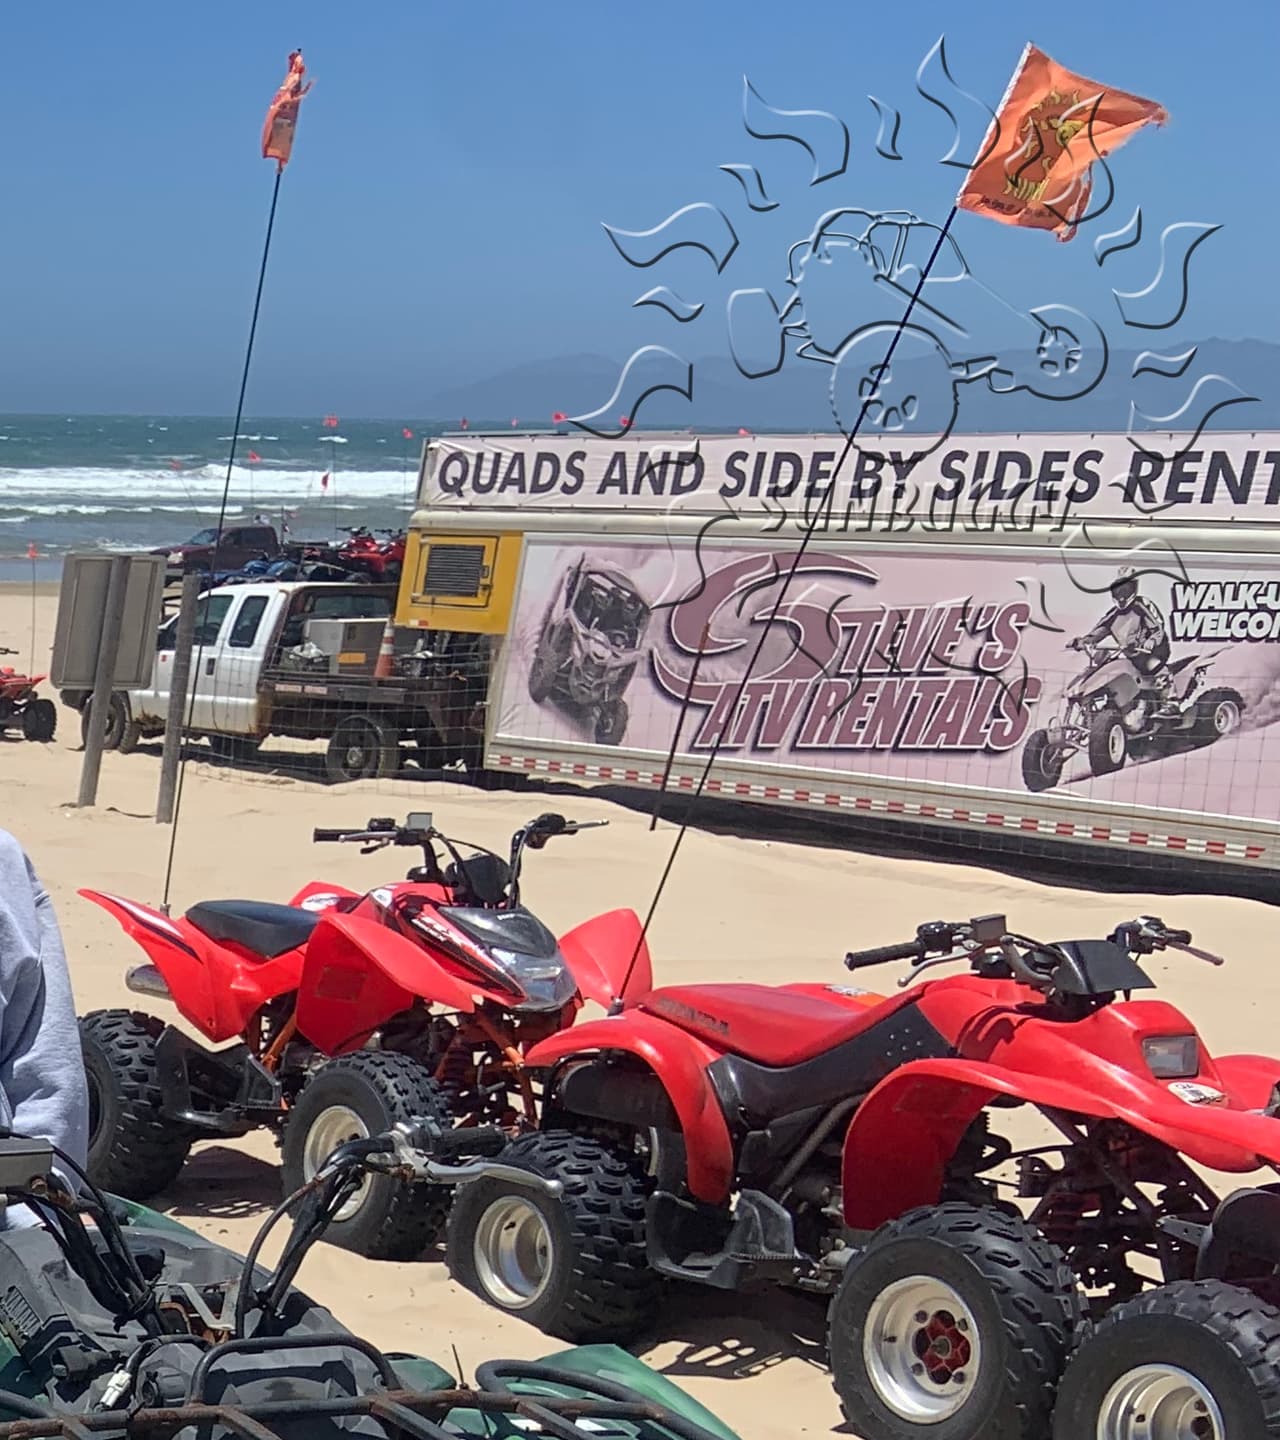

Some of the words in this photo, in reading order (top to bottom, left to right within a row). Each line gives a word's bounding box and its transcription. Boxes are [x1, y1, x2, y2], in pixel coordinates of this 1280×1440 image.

[438, 450, 586, 498] QUADS
[597, 450, 705, 496] AND
[718, 449, 836, 499] SIDE
[849, 450, 926, 500] BY
[937, 449, 1105, 502] SIDES
[1121, 450, 1280, 505] RENT
[692, 677, 814, 750] ATV
[794, 675, 1042, 752] RENTALS
